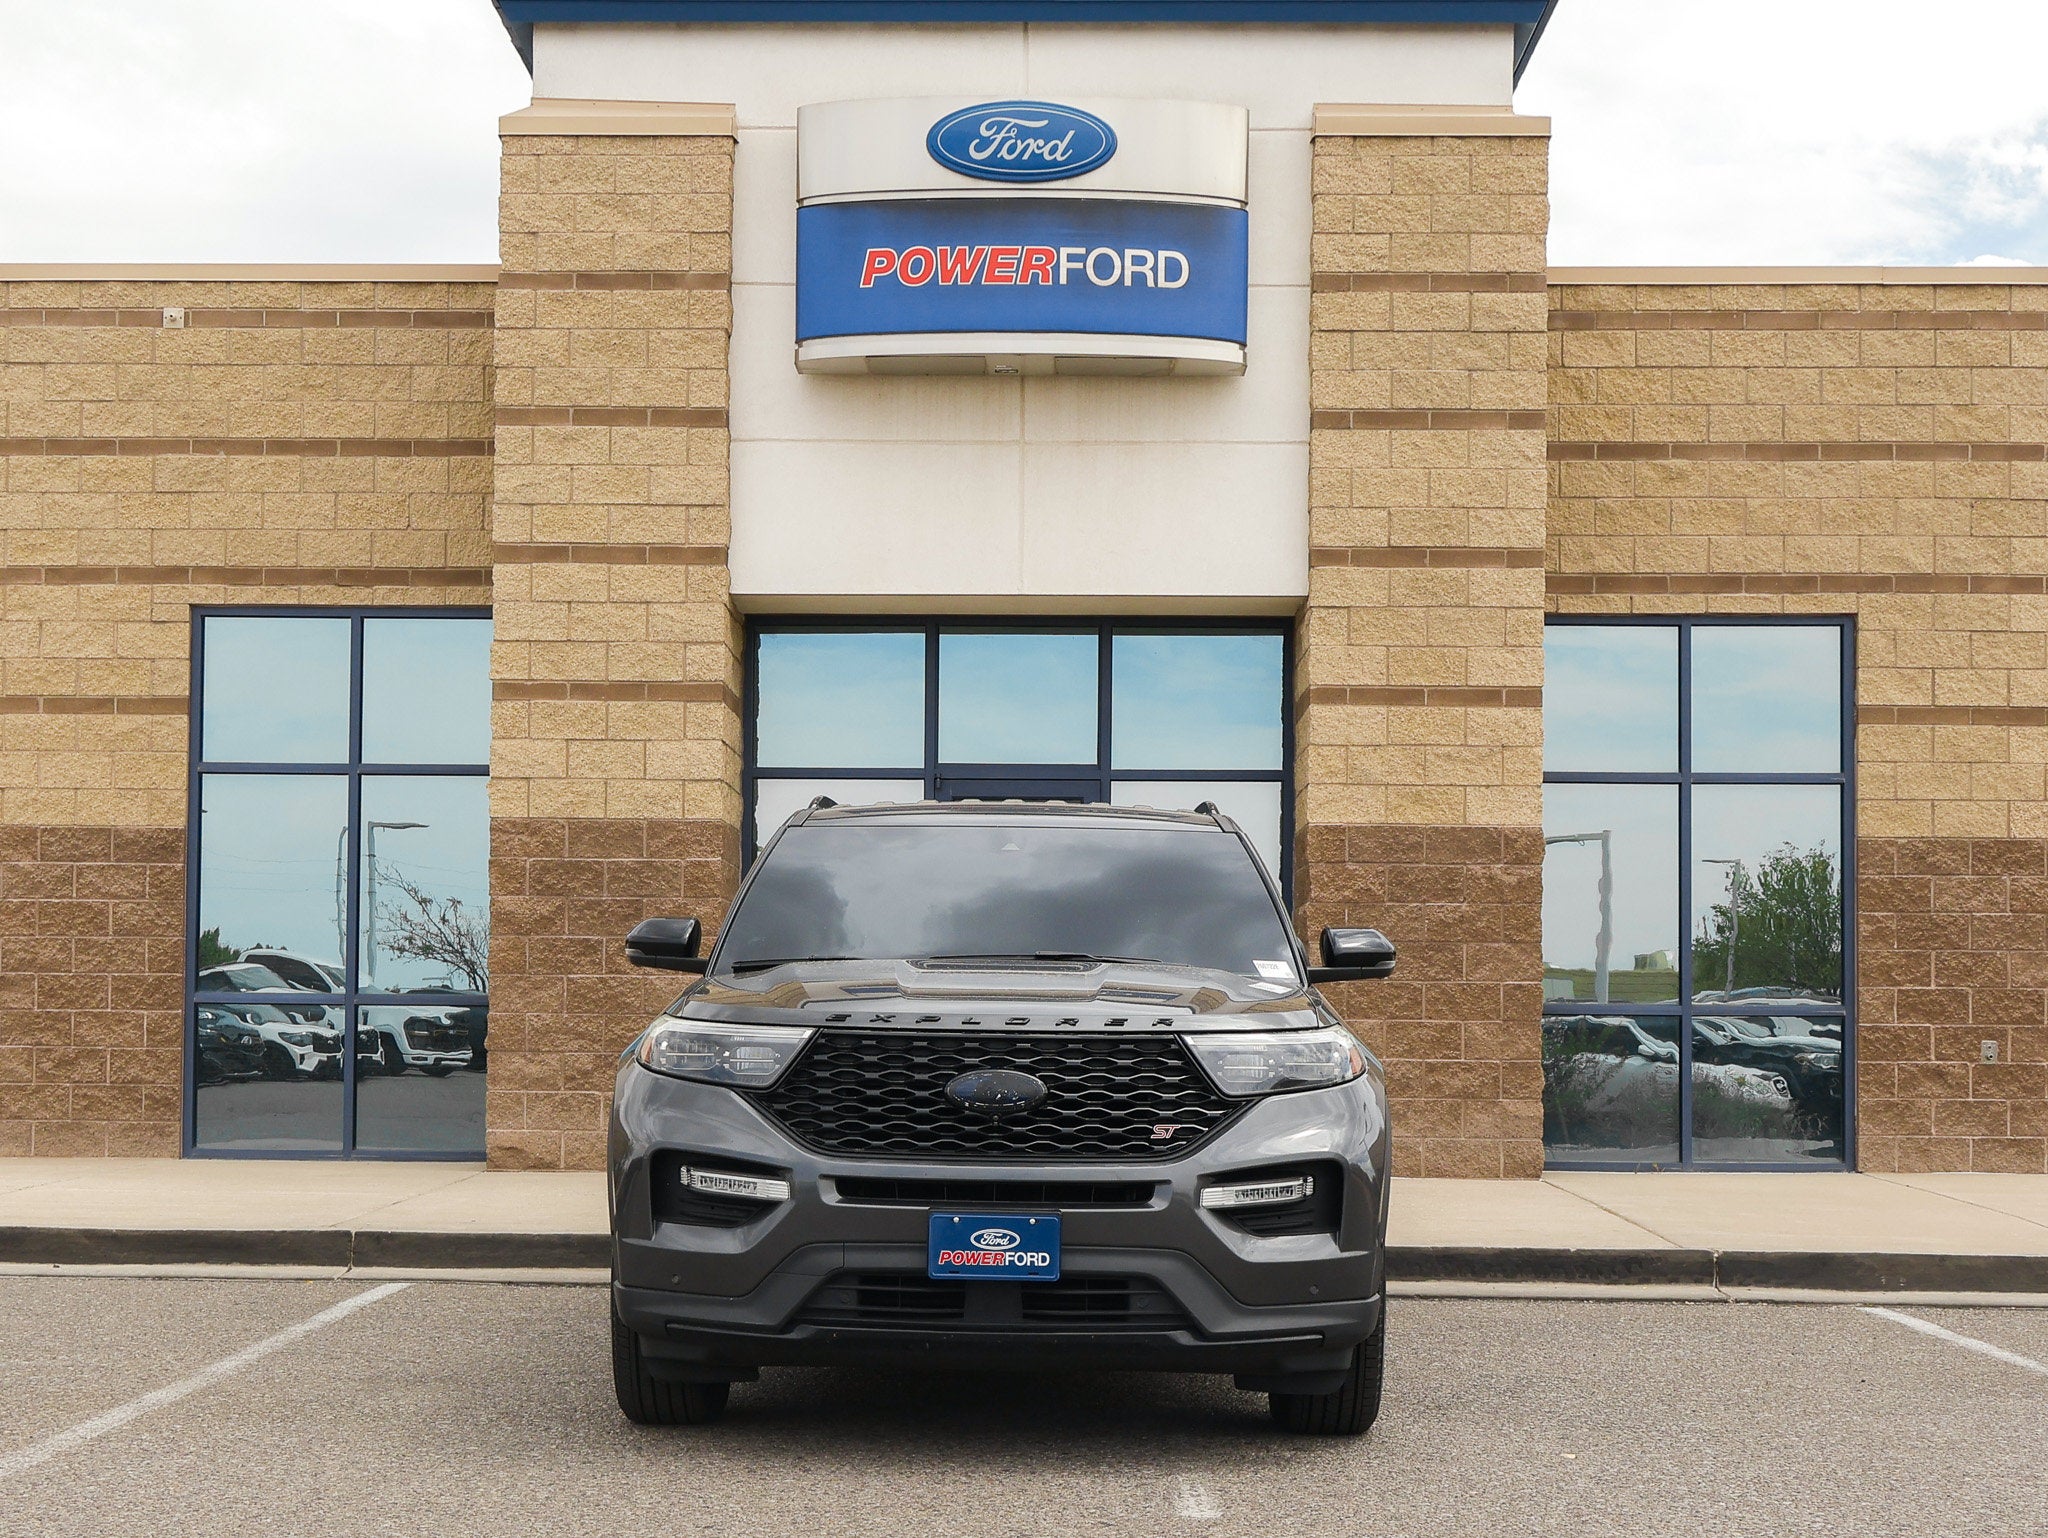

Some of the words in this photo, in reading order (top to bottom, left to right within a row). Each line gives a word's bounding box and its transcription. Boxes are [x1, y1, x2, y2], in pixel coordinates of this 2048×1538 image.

[968, 116, 1075, 162] Ford
[859, 245, 1190, 289] POWERFORD
[825, 1013, 1176, 1027] EXPLORER
[1151, 1124, 1181, 1139] ST
[980, 1232, 1010, 1246] Ford
[938, 1250, 1050, 1267] POWERFORD
